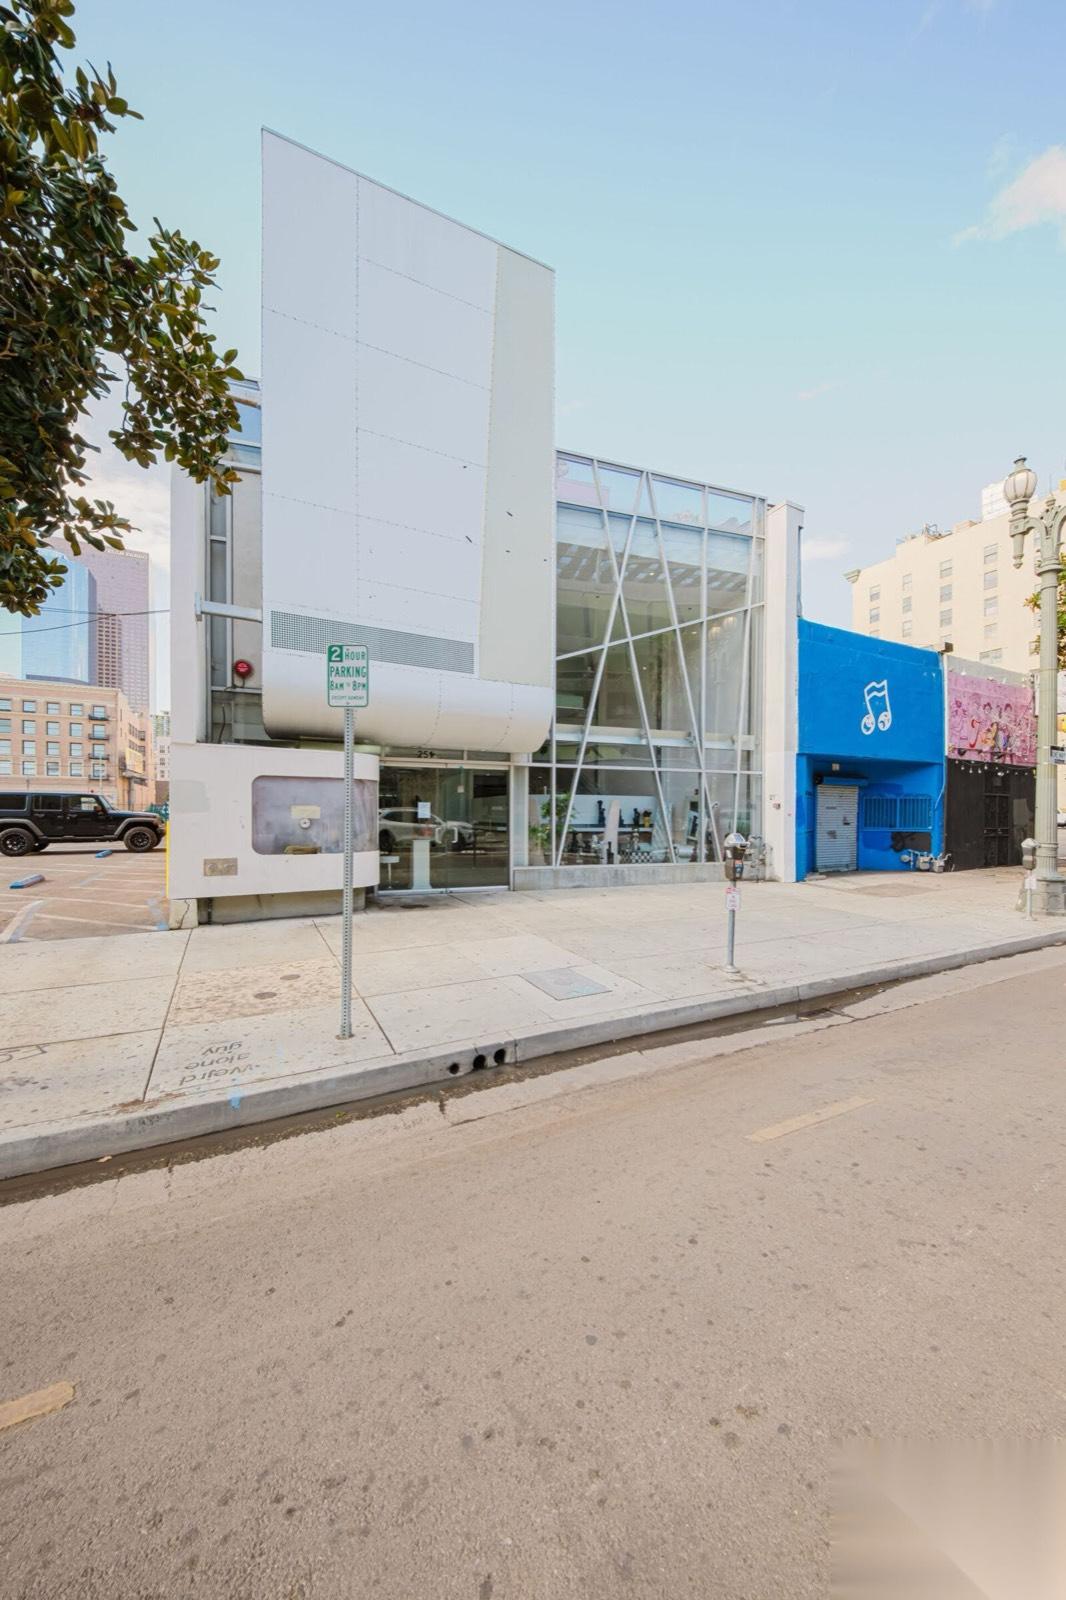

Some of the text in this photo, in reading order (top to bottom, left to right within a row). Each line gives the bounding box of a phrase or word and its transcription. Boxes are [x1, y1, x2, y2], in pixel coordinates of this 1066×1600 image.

[331, 647, 366, 661] 2 HOUR
[330, 665, 367, 678] PARKING
[330, 680, 345, 691] 8AM
[352, 680, 367, 692] 8PM
[201, 1041, 242, 1056] guy
[184, 1053, 250, 1070] alone
